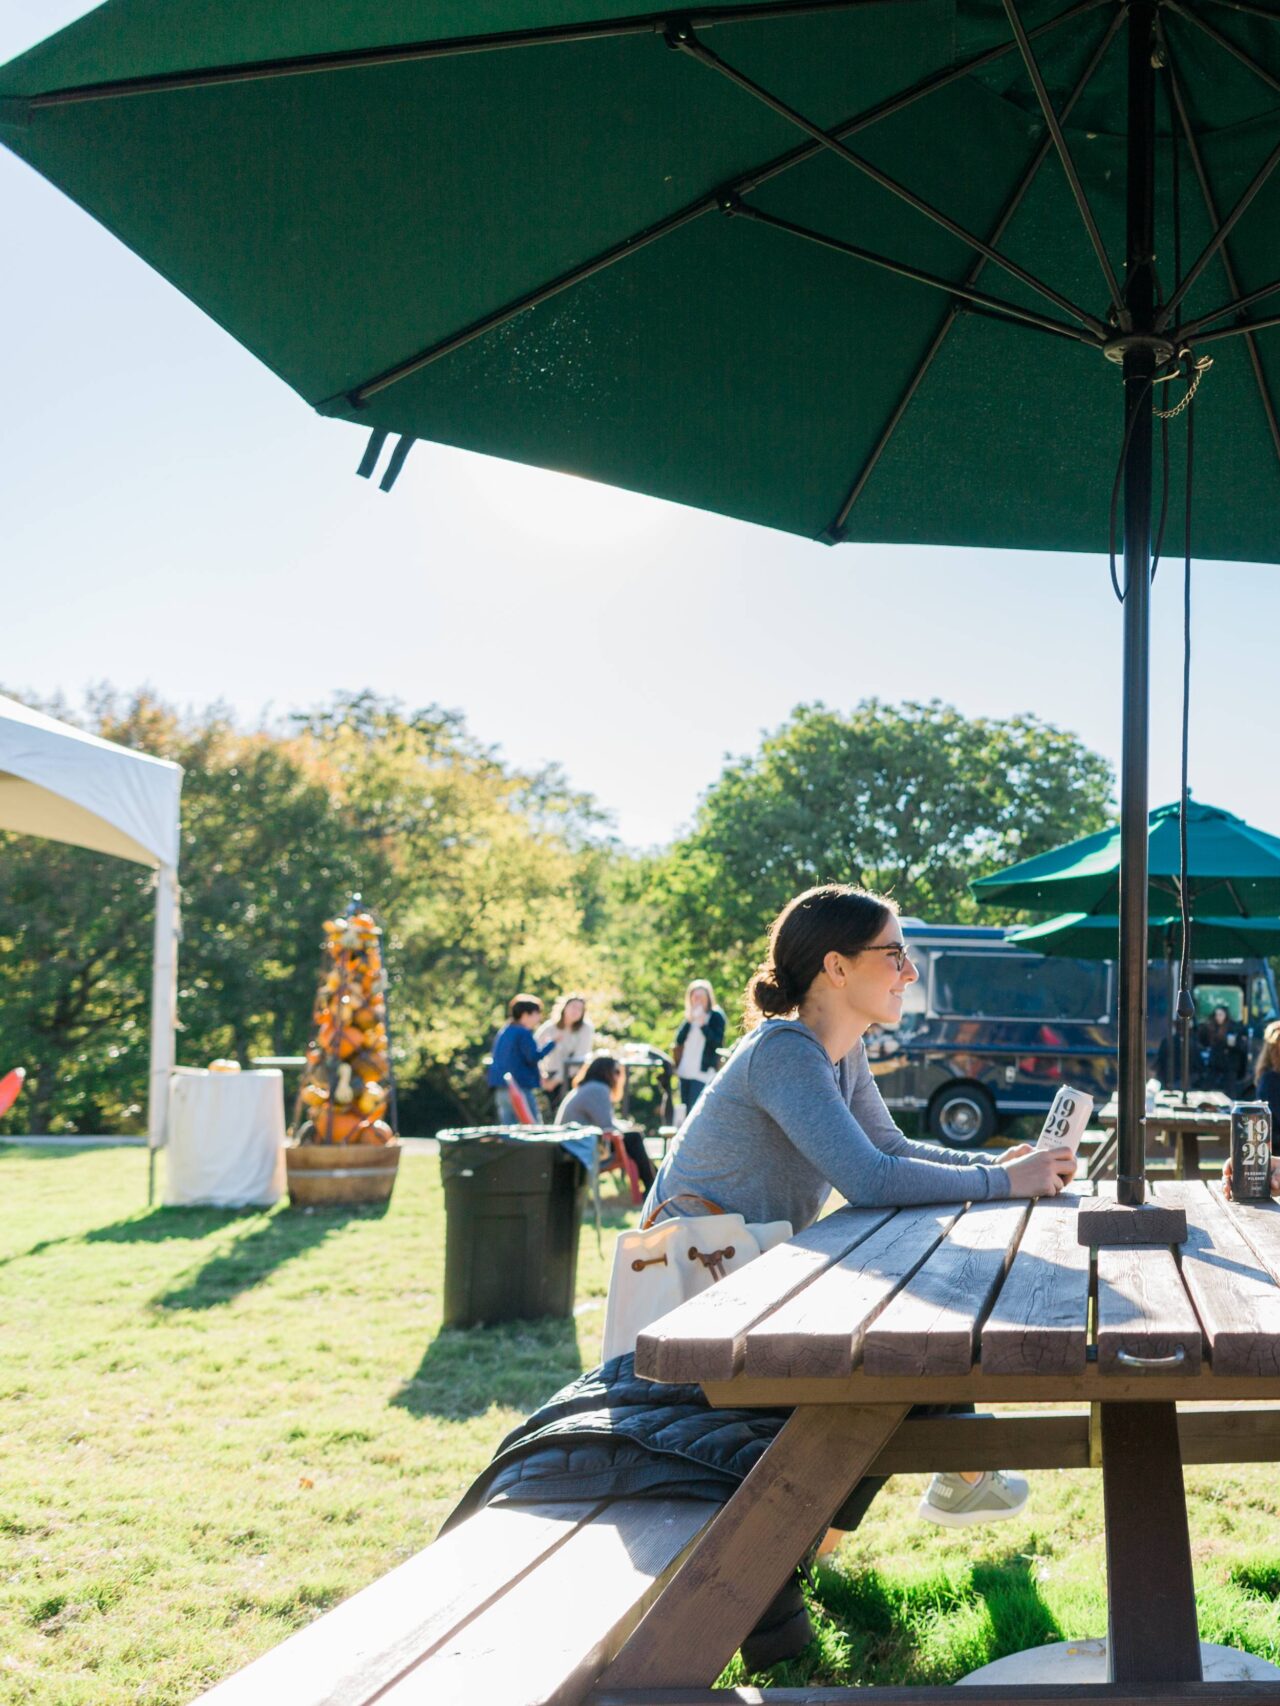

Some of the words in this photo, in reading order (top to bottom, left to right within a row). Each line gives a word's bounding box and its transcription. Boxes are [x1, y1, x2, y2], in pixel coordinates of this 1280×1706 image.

[1054, 1096, 1075, 1118] 19
[1045, 1114, 1070, 1138] 29
[1244, 1119, 1269, 1142] 19
[1241, 1143, 1269, 1166] 29
